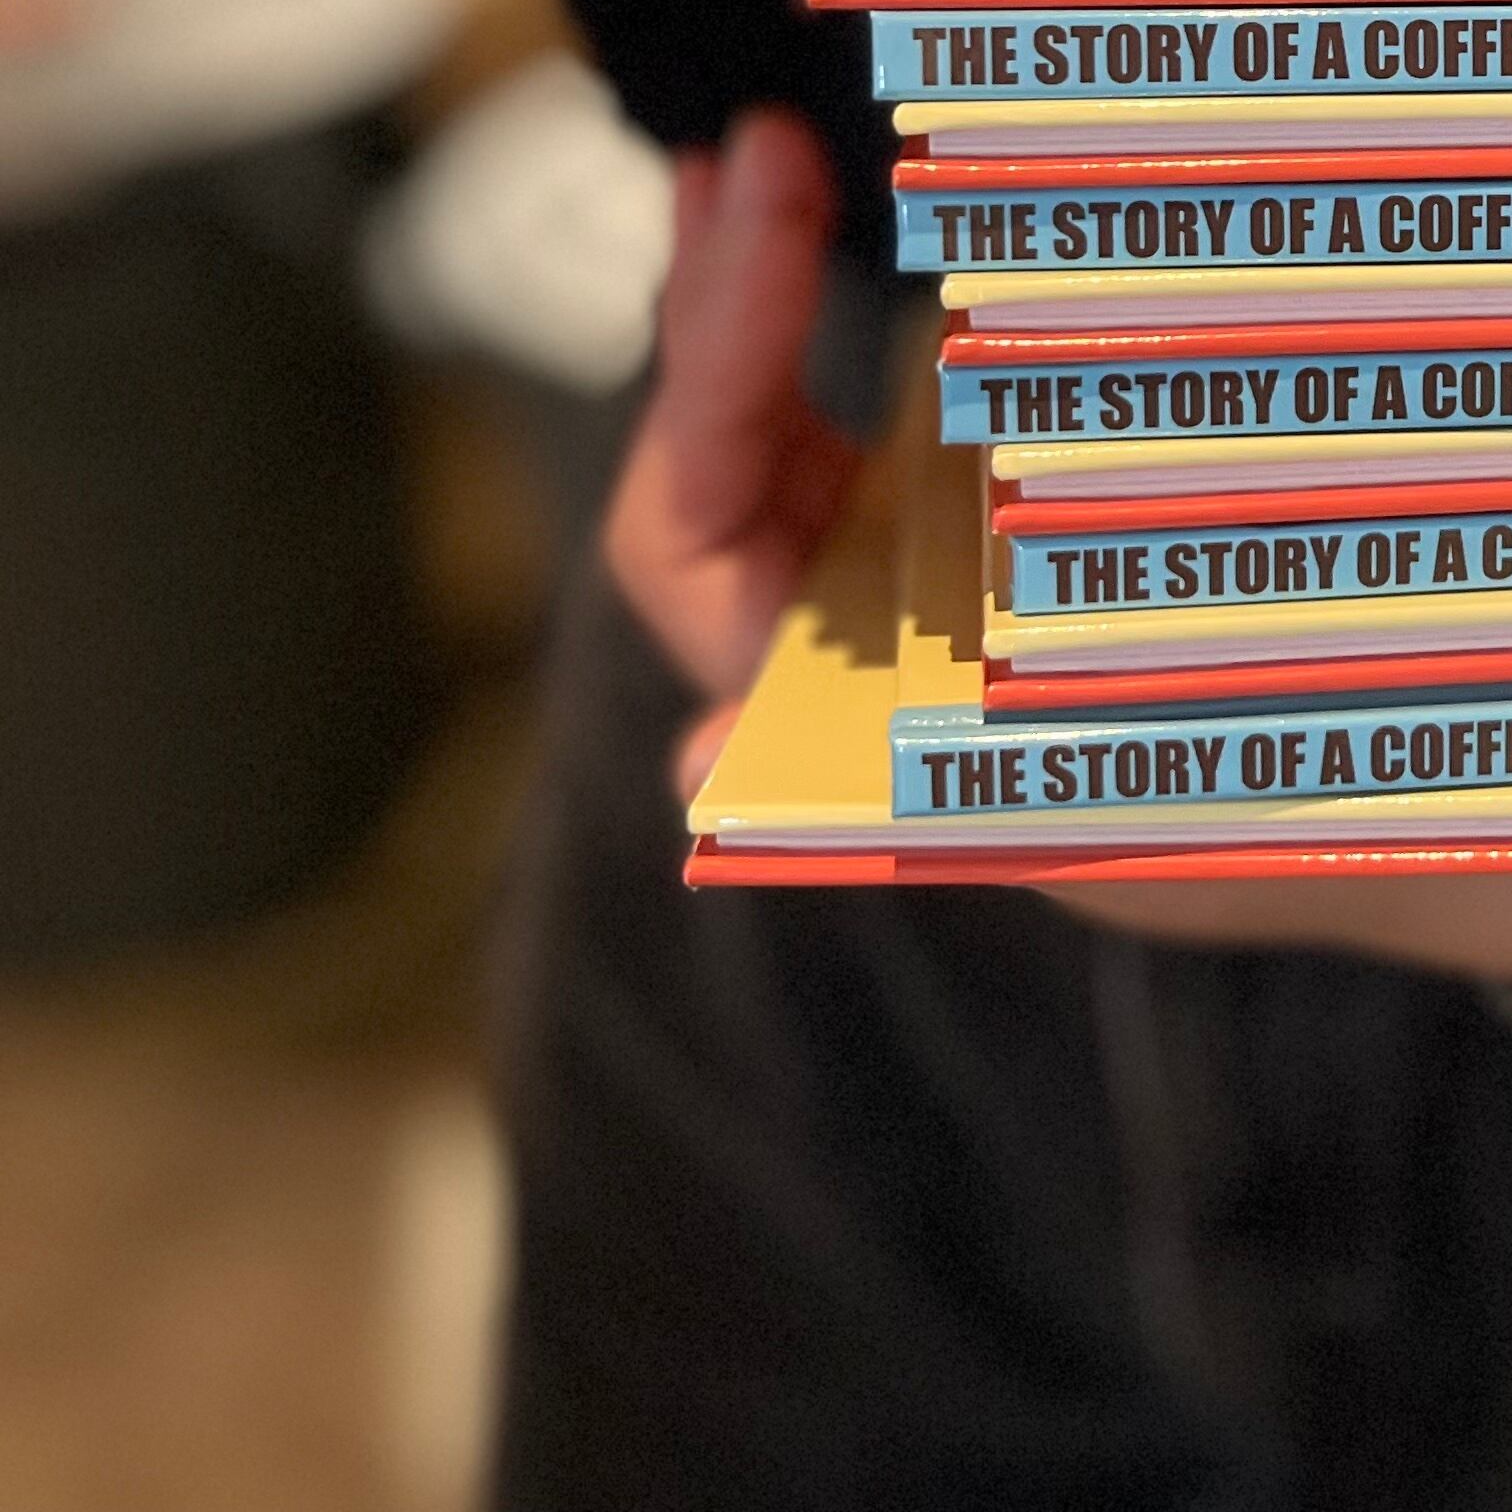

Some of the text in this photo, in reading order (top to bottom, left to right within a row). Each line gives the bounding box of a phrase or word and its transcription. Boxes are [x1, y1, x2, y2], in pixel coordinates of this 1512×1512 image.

[912, 26, 1019, 87] THE
[1034, 24, 1219, 86] STORY
[1233, 22, 1300, 83] OF
[1312, 21, 1350, 80] A
[933, 203, 1039, 263] THE
[1052, 200, 1236, 261] STORY
[1250, 198, 1316, 257] OF
[1328, 197, 1366, 255] A
[979, 376, 1085, 435] THE
[1098, 369, 1280, 431] STORY
[1294, 366, 1360, 425] OF
[1372, 365, 1409, 421] A
[1047, 546, 1151, 606] THE
[1165, 535, 1344, 600] STORY
[1357, 531, 1422, 589] OF
[1432, 529, 1469, 584] A
[922, 748, 1028, 809] THE
[1042, 736, 1227, 805] STORY
[1241, 731, 1307, 793] OF
[1320, 729, 1357, 787] A
